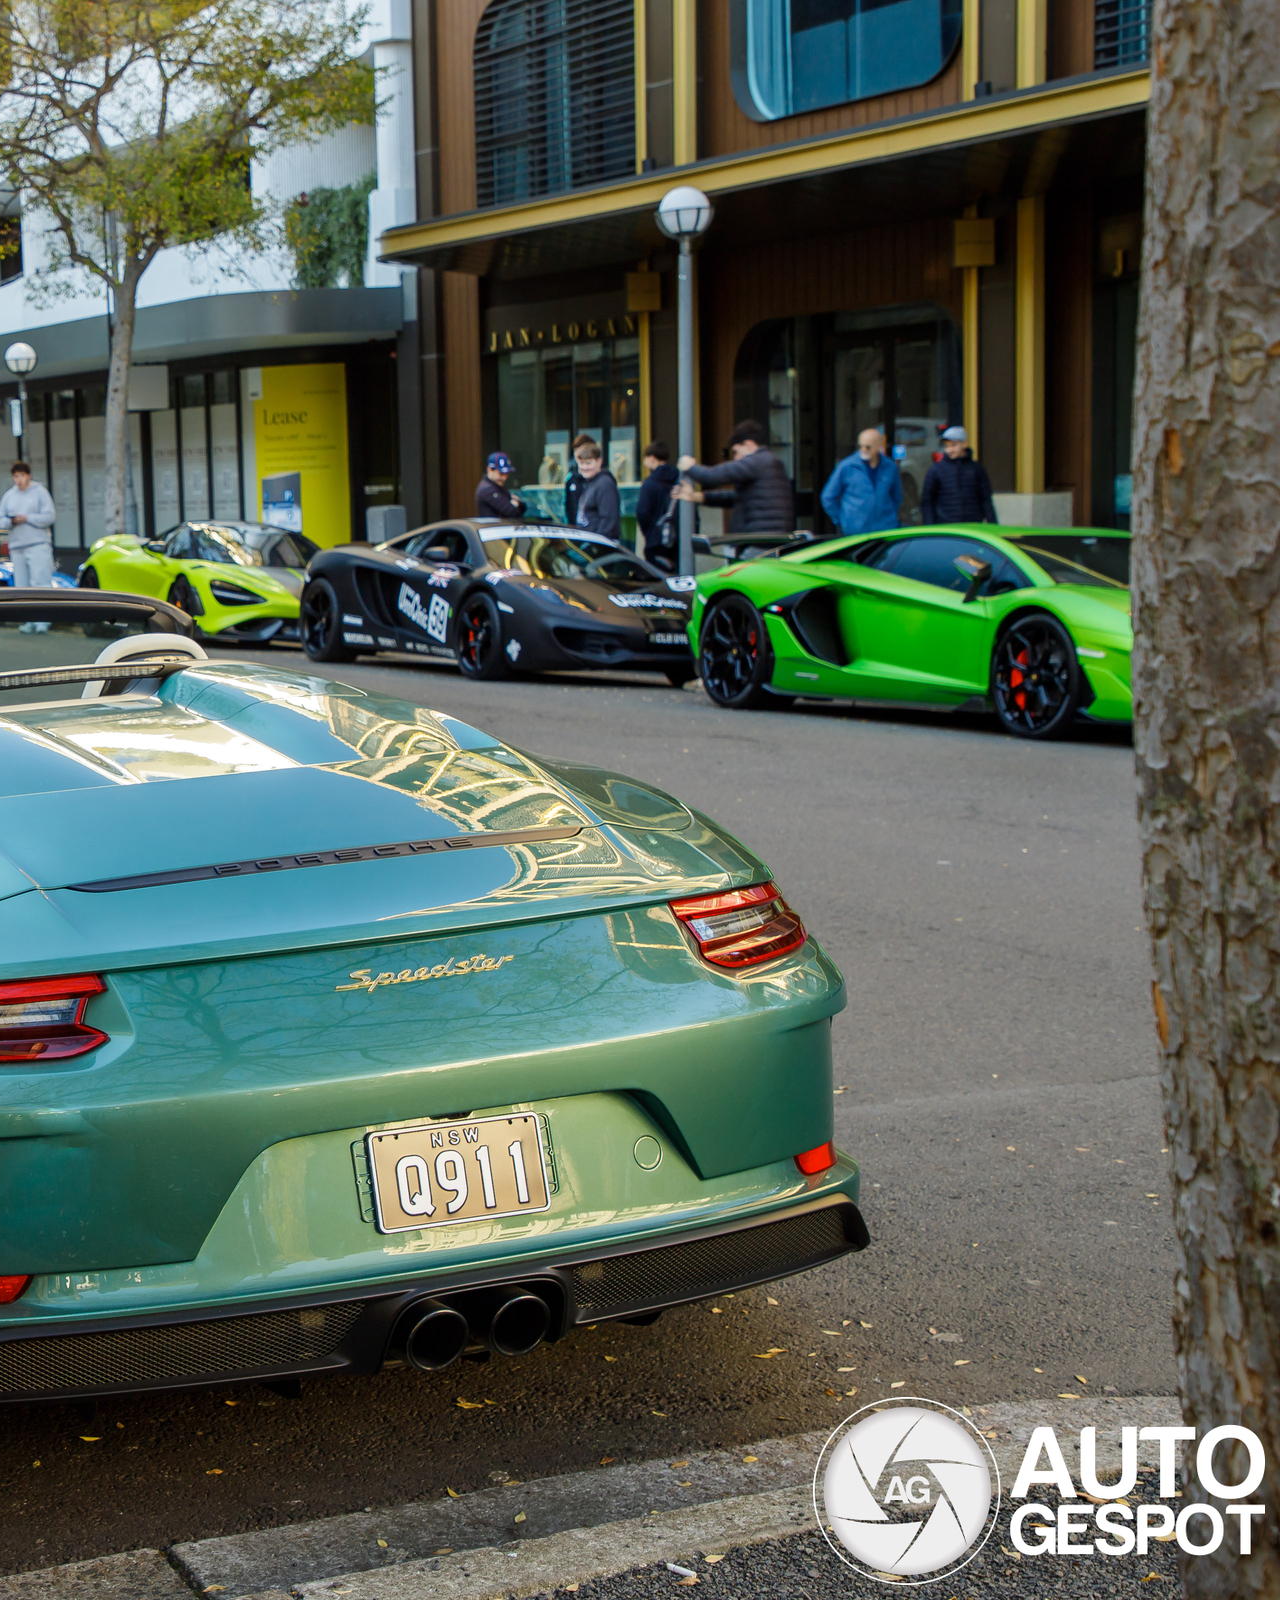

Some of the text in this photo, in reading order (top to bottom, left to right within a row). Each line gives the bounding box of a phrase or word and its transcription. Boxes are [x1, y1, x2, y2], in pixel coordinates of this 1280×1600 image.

[490, 315, 635, 352] JAN LOGAN
[262, 408, 308, 425] Lease
[431, 601, 445, 635] 59
[334, 953, 515, 993] Speedster
[431, 1127, 479, 1148] NSW
[396, 1140, 530, 1217] Q911
